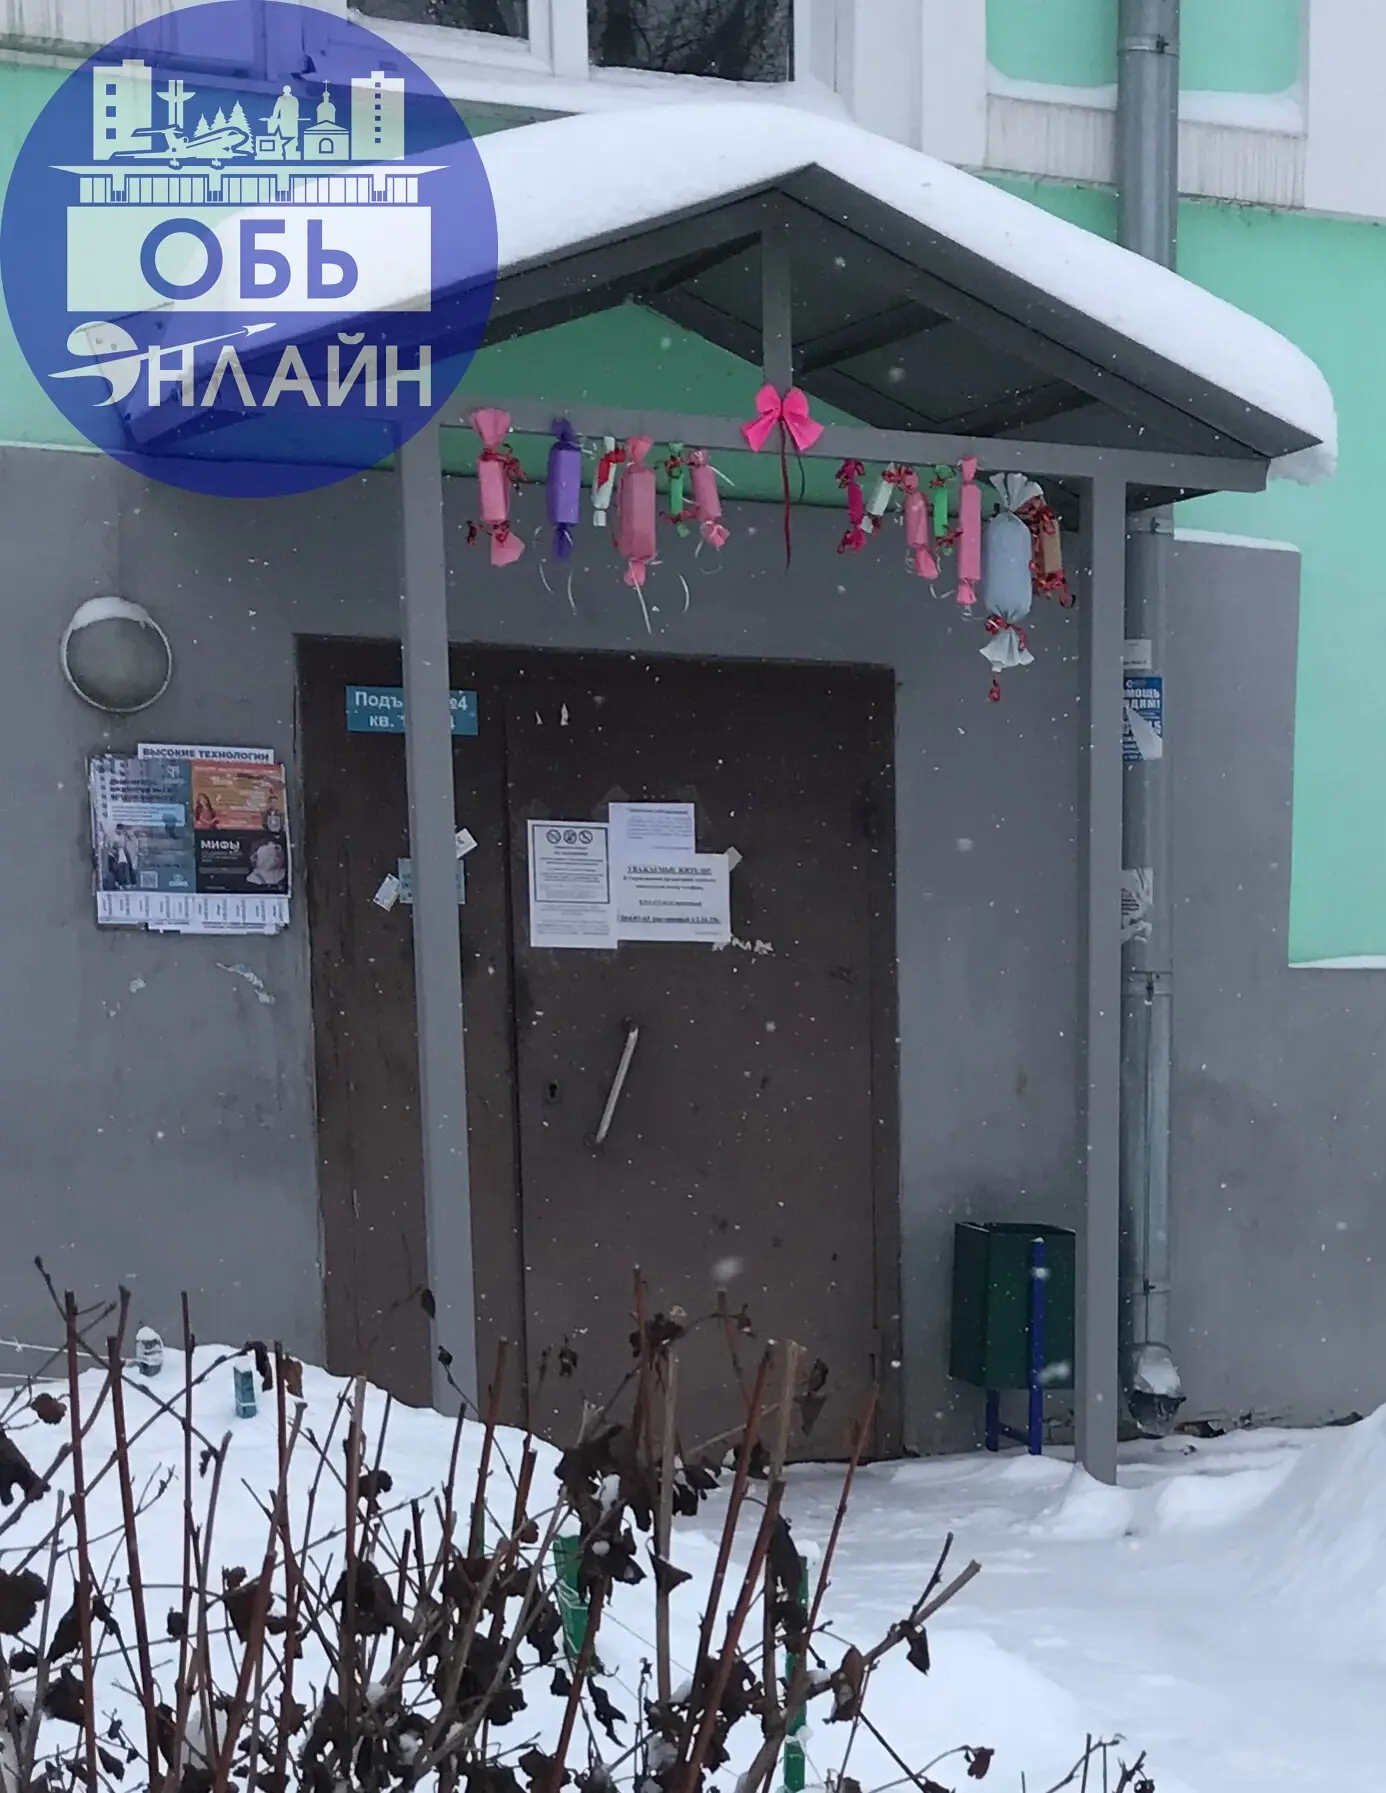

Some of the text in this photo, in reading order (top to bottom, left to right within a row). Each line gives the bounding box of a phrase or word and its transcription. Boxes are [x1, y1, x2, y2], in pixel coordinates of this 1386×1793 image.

[1124, 689, 1161, 698] МОЩЬ
[355, 691, 404, 709] Подъ
[1126, 699, 1161, 709] ДЯМ!
[369, 715, 394, 728] кв.
[142, 747, 270, 761] ВЫСОКИЕ ТЕХНОЛОГИИ
[200, 840, 241, 852] МИФЫ
